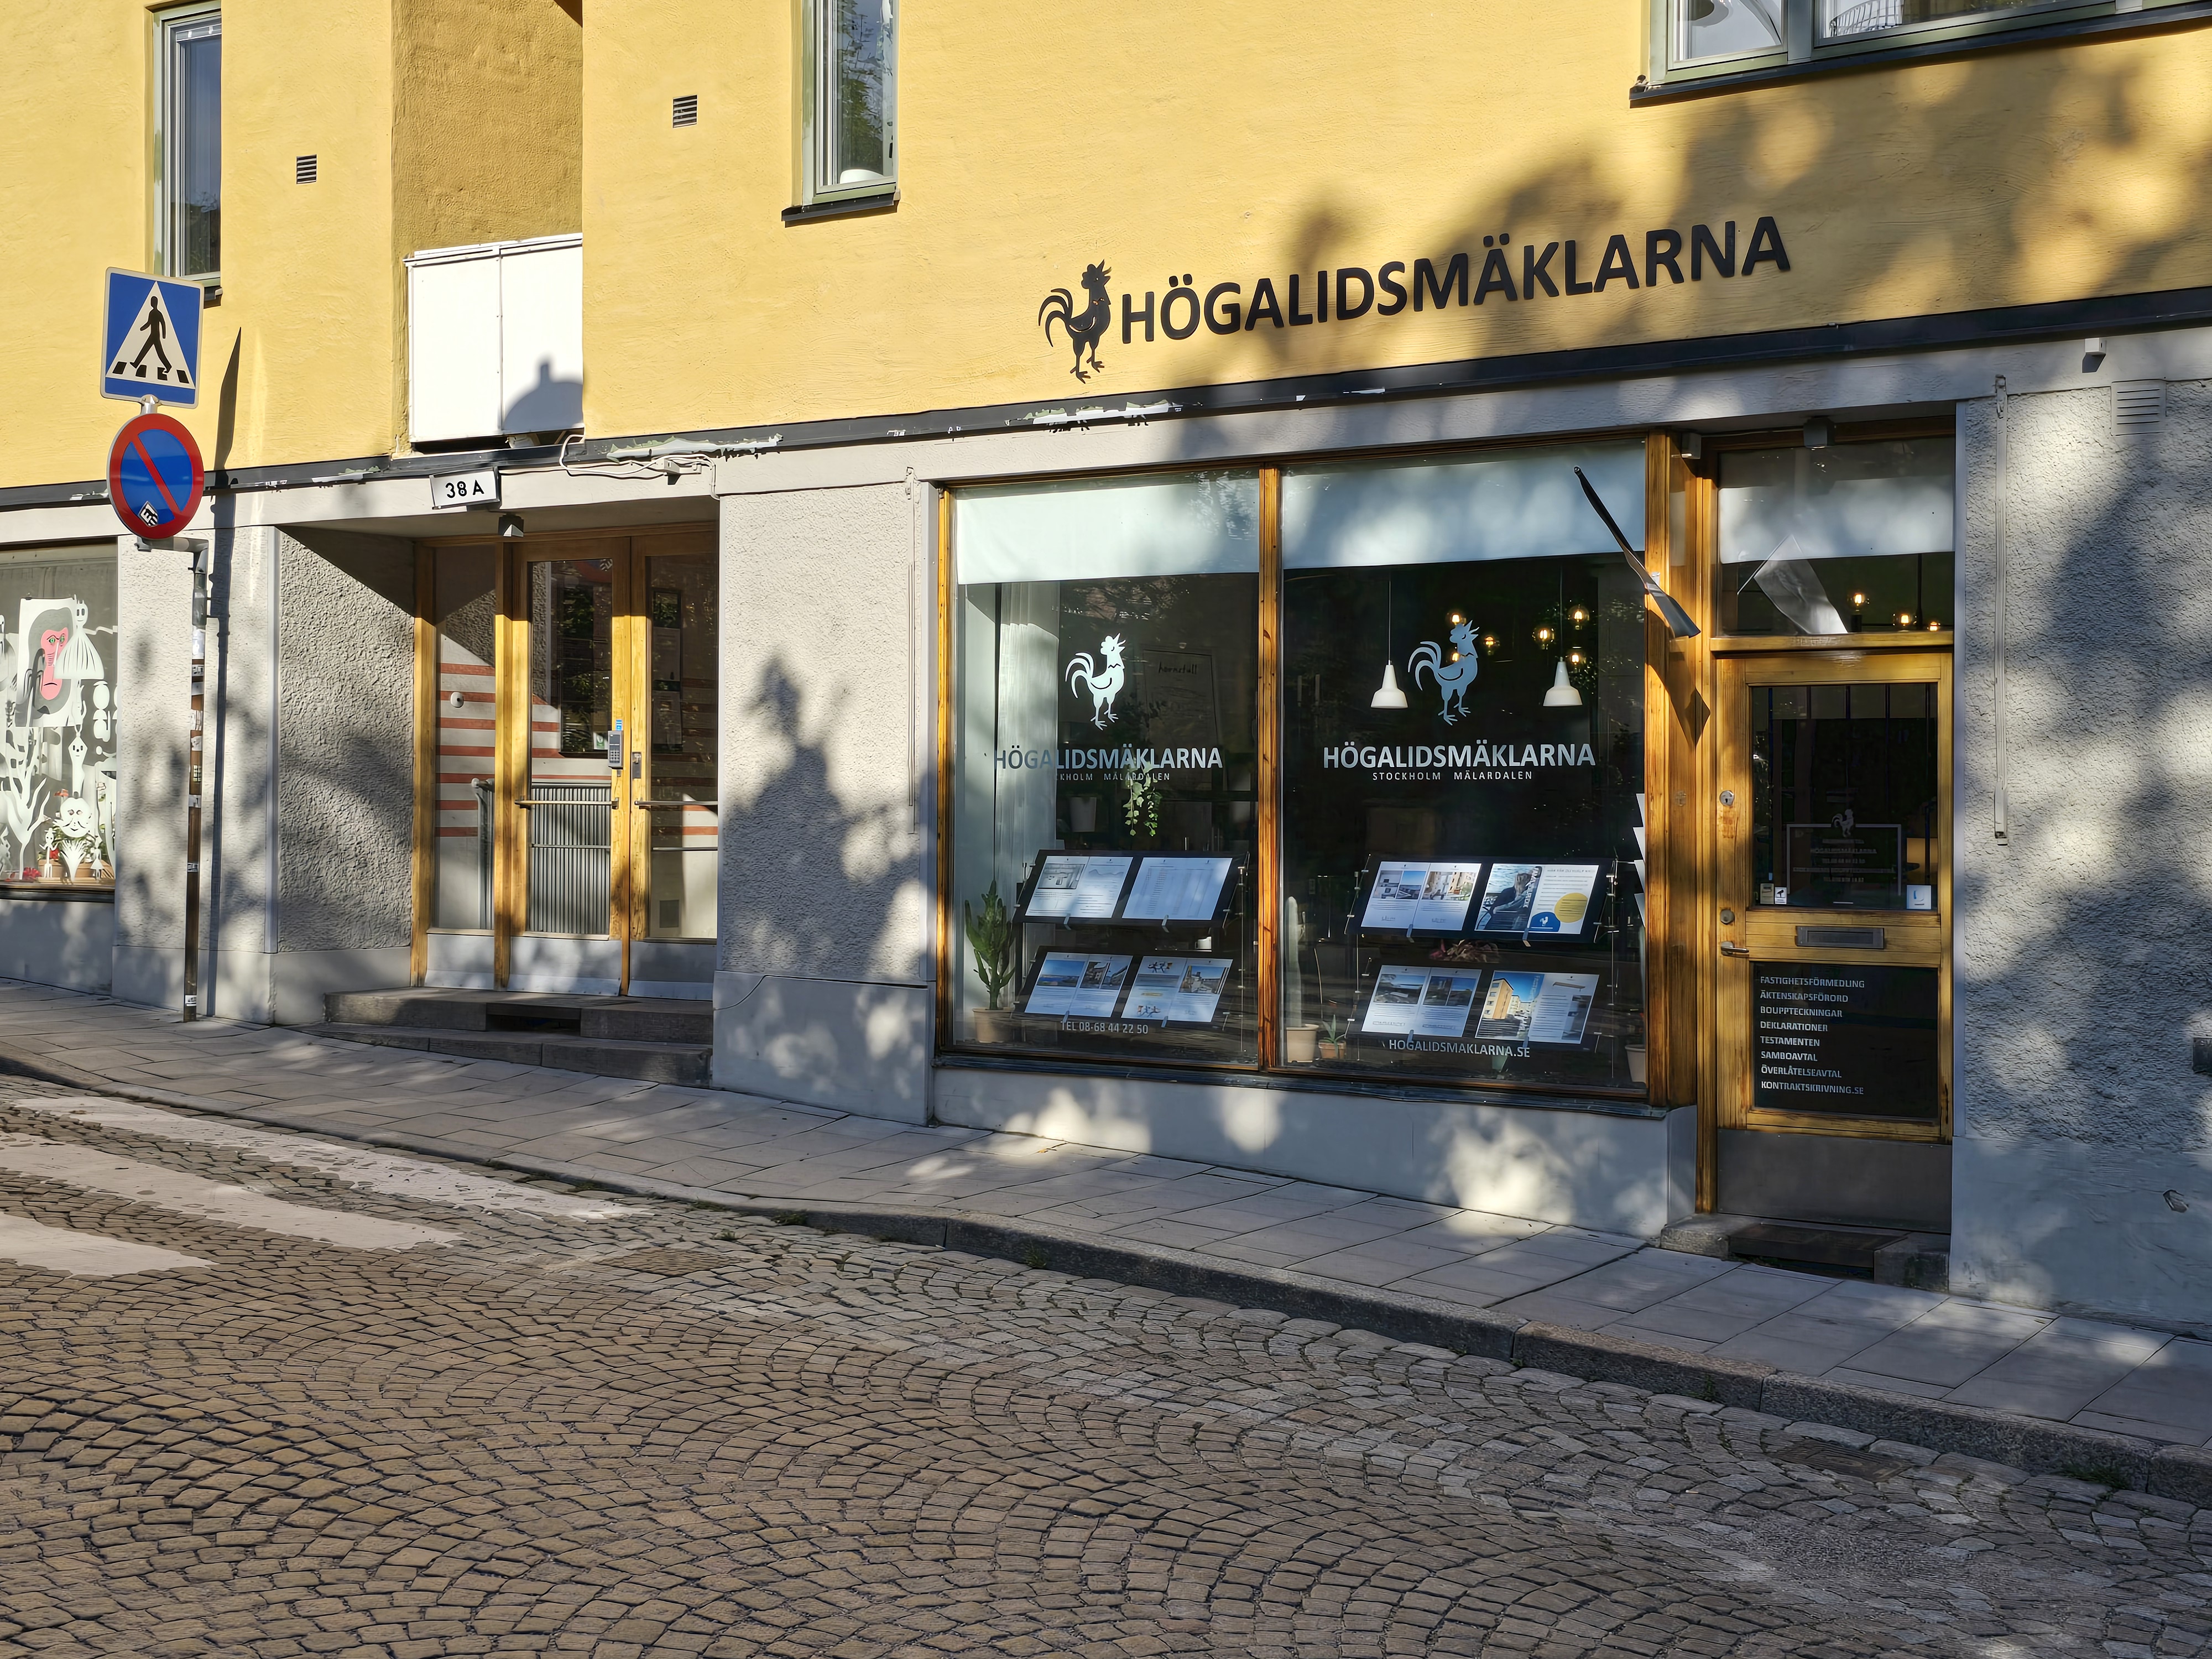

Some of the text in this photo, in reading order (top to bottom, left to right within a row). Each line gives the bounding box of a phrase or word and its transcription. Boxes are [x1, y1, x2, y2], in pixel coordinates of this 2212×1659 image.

[1122, 216, 1791, 344] HÖGALIDSMÄKLARNA
[446, 479, 484, 499] 38 A
[995, 743, 1223, 770] HÖGALIDSMÄKLARNA
[1323, 739, 1597, 769] HÖGALIDSMÄKLARNA
[1372, 770, 1532, 781] STOCKHOLM MÄLARDALEN
[1760, 976, 1865, 988] FASTIGHETSFÖRMEDLING
[1760, 990, 1849, 1003] ÄKTENSKAPSFÖRORD
[1760, 1006, 1843, 1018] BOUPPTECKNINGAR
[1061, 1021, 1149, 1034] TEL 08-68 44 22 50
[1760, 1021, 1828, 1032] DEKLARATIONER
[1389, 1039, 1530, 1057] HOGALIDSMAKLARNA.SE
[1760, 1036, 1820, 1047] TESTAMENTEN
[1761, 1051, 1818, 1062] SAMBOAVTAL
[1761, 1064, 1842, 1078] ÖVERLÅTELSEAVTAL
[1761, 1081, 1864, 1095] KONTRAKTSKRIVNING.SE
